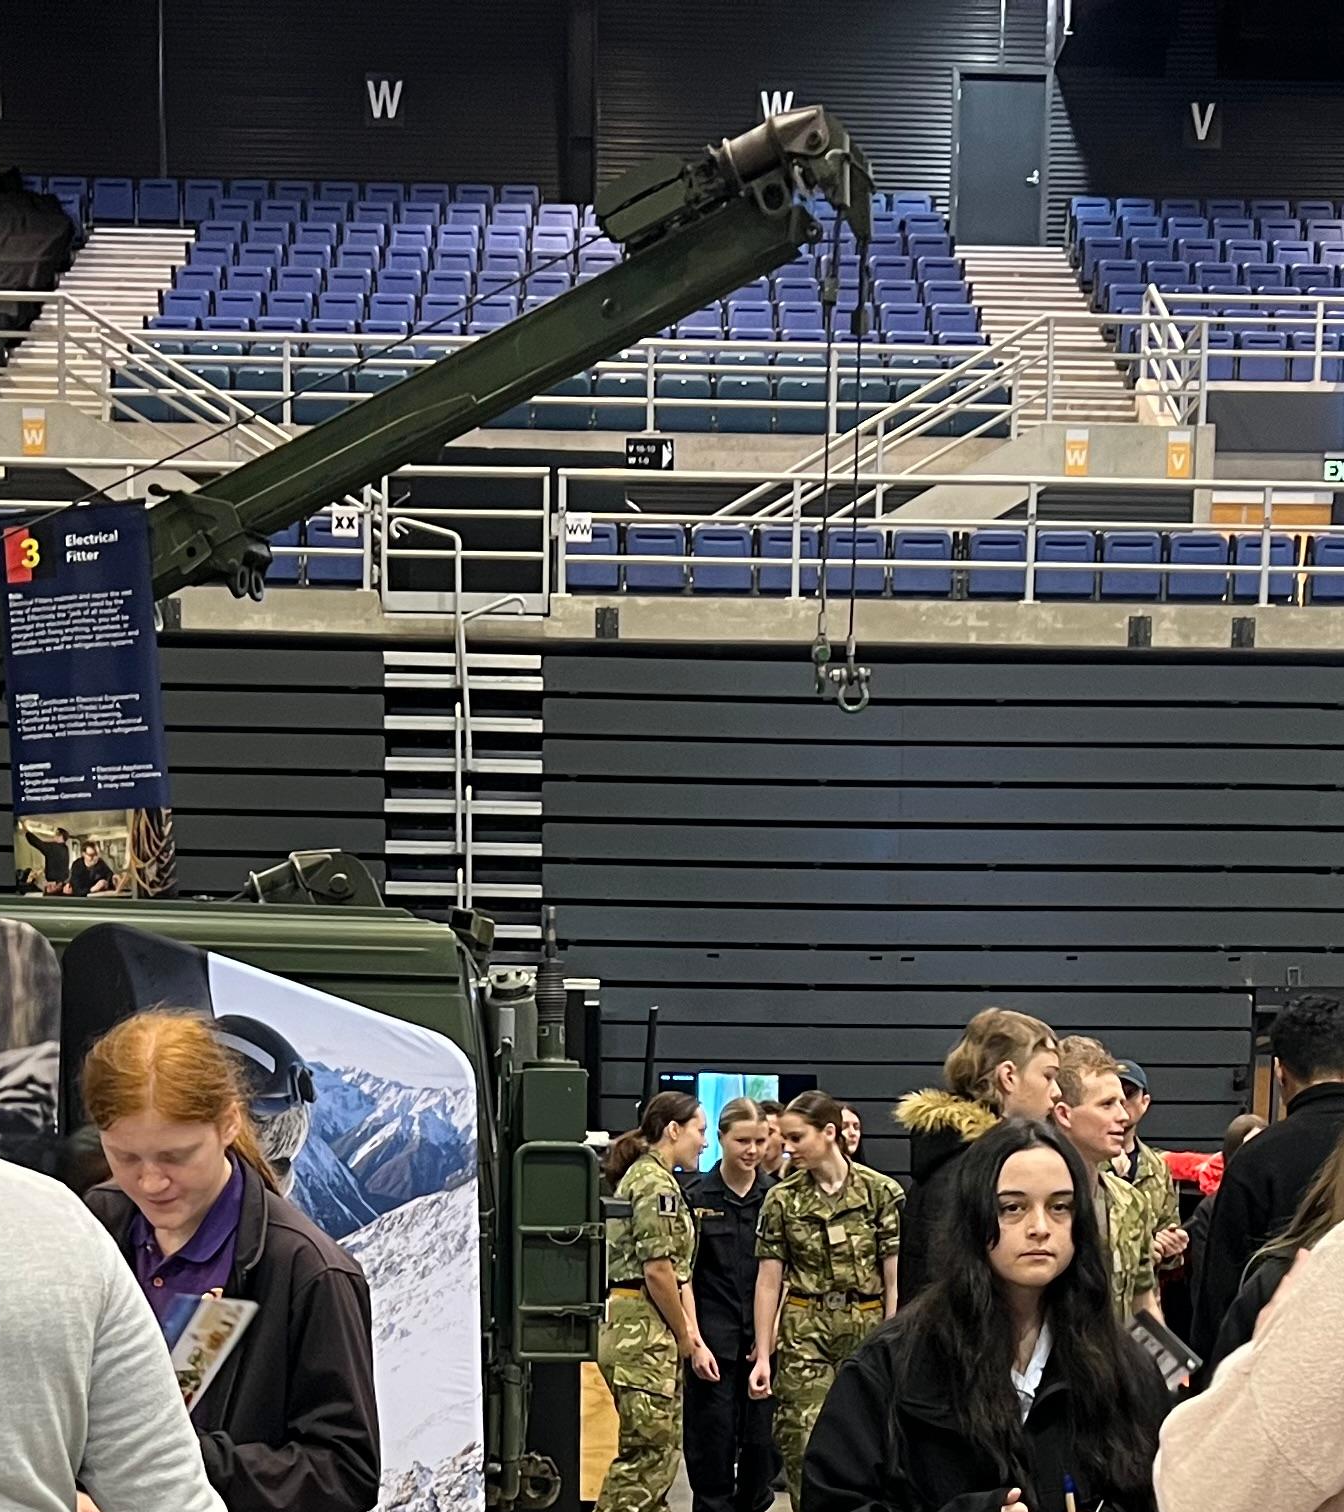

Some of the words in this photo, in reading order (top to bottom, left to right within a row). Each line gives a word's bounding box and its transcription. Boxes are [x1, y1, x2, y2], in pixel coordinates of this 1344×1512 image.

[367, 81, 403, 119] W
[760, 90, 794, 119] W
[1191, 102, 1216, 141] V
[23, 428, 44, 446] W
[1066, 448, 1087, 466] W
[1171, 453, 1185, 470] V
[335, 516, 355, 530] XX
[566, 524, 592, 536] WW
[65, 530, 119, 548] Electrical
[20, 538, 40, 569] 3
[66, 549, 99, 563] Fitter
